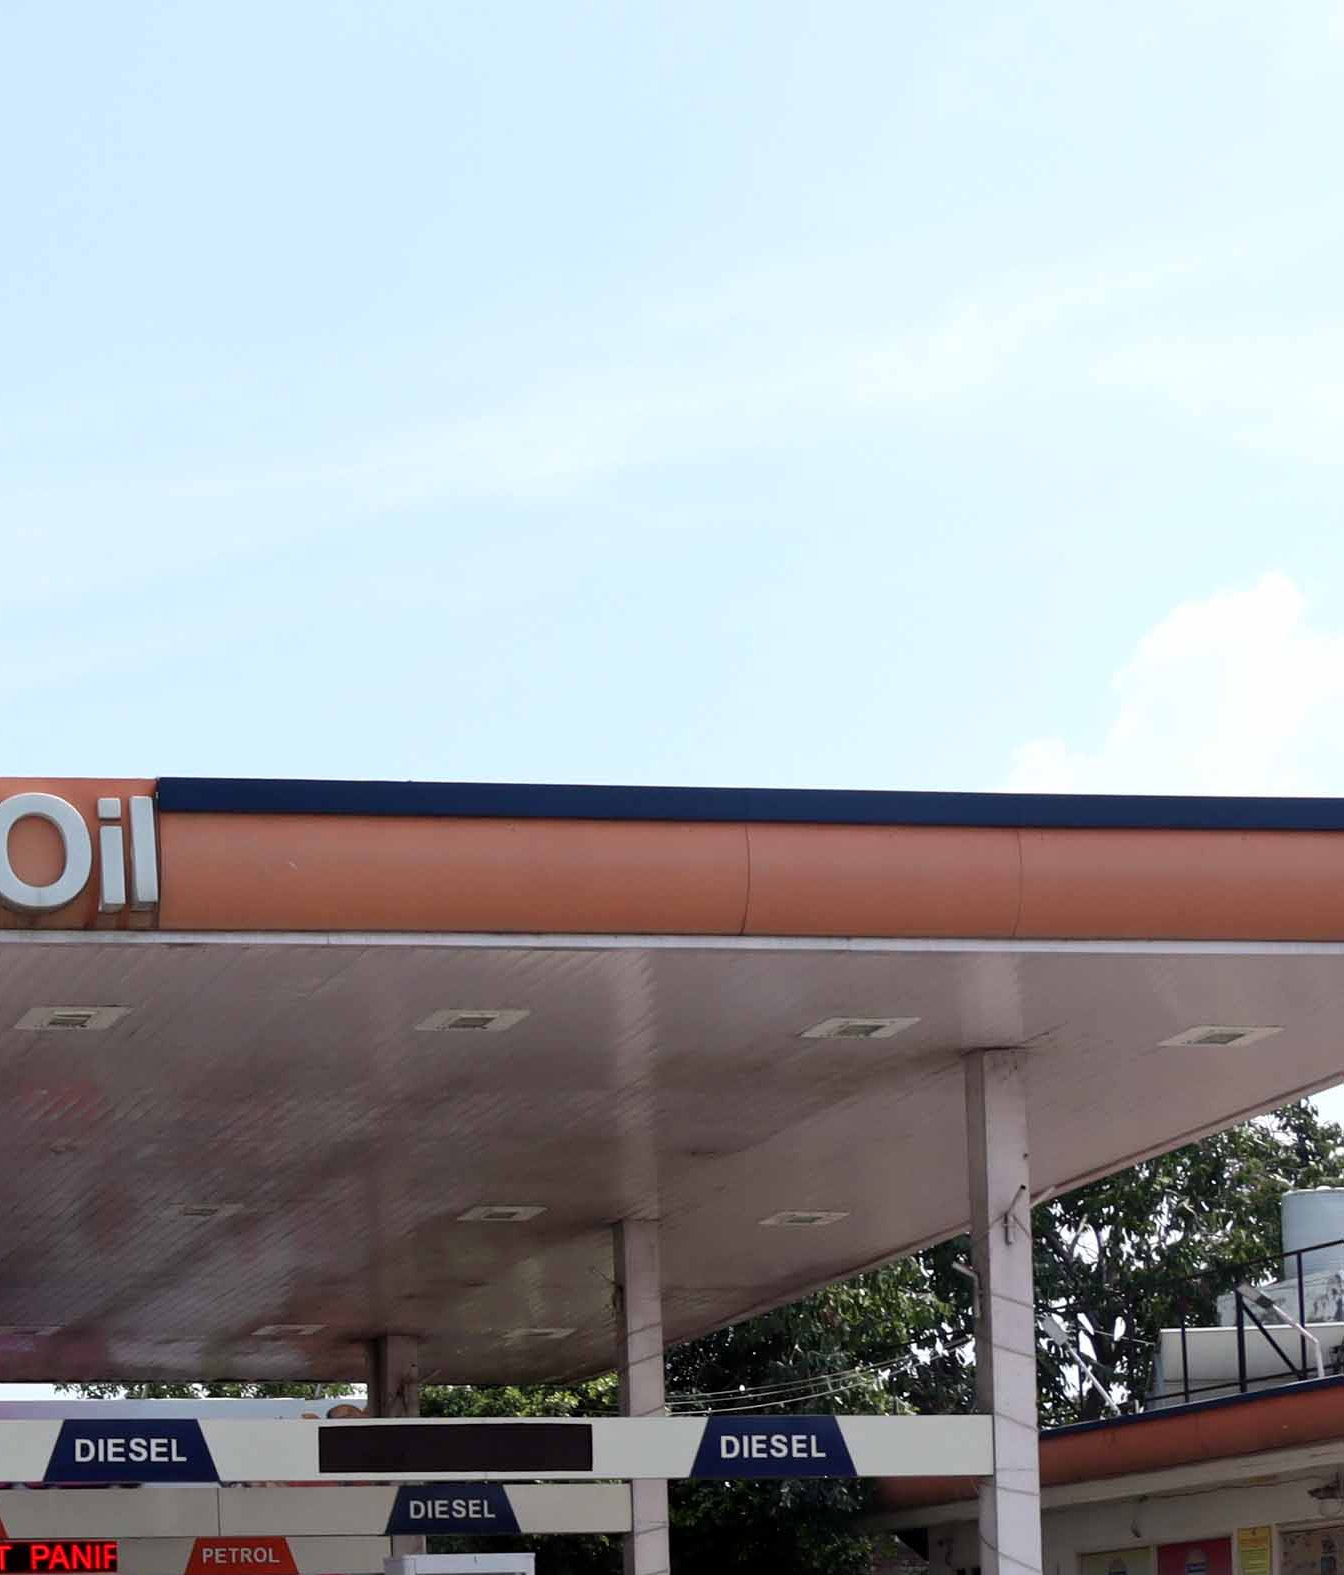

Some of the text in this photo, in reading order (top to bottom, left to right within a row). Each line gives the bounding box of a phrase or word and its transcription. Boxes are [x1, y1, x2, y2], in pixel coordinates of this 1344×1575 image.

[74, 1438, 187, 1464] DIESEL
[720, 1435, 826, 1459] DIESEL
[410, 1499, 496, 1520] DIESEL
[202, 1546, 280, 1564] PETROL
